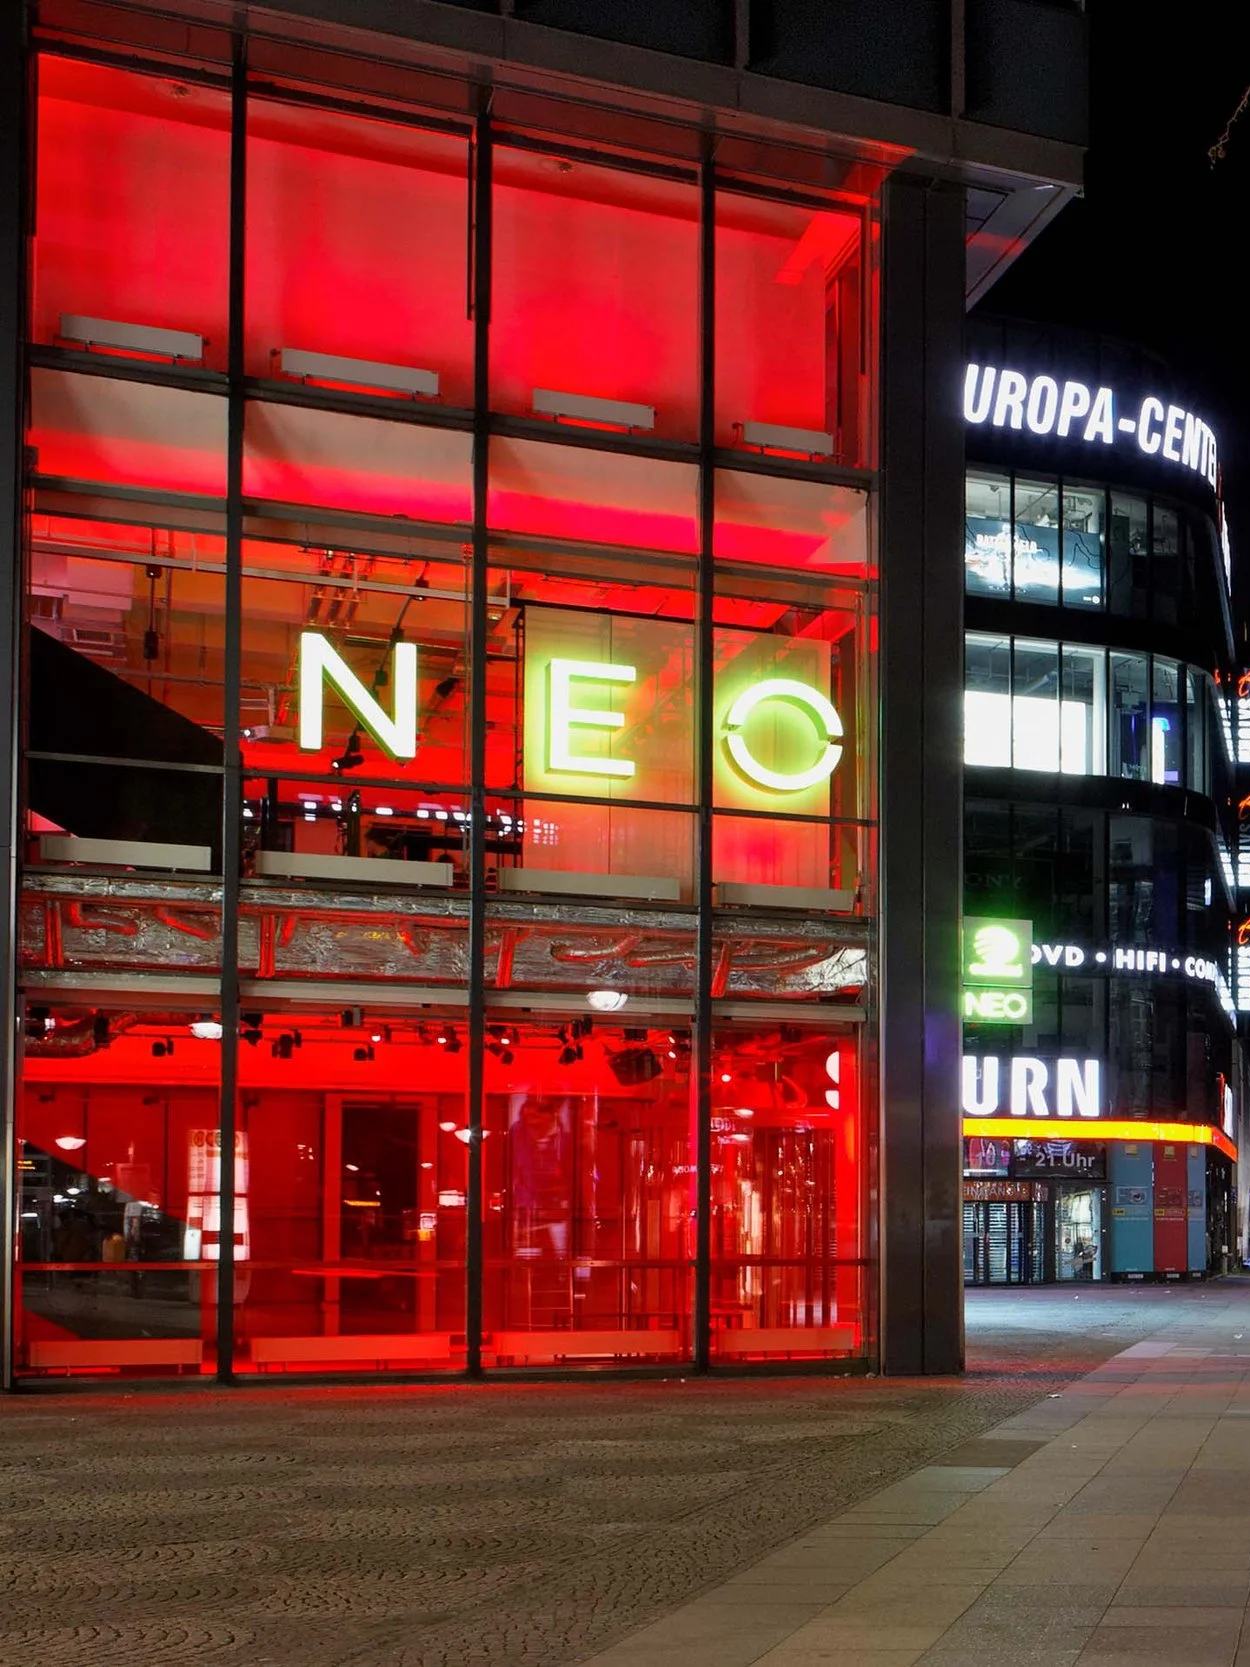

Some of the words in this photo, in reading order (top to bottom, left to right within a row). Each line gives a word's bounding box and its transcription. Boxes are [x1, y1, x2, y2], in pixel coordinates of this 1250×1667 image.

[299, 631, 844, 793] NEO
[1115, 949, 1166, 972] HIFI
[964, 991, 1028, 1019] NEO
